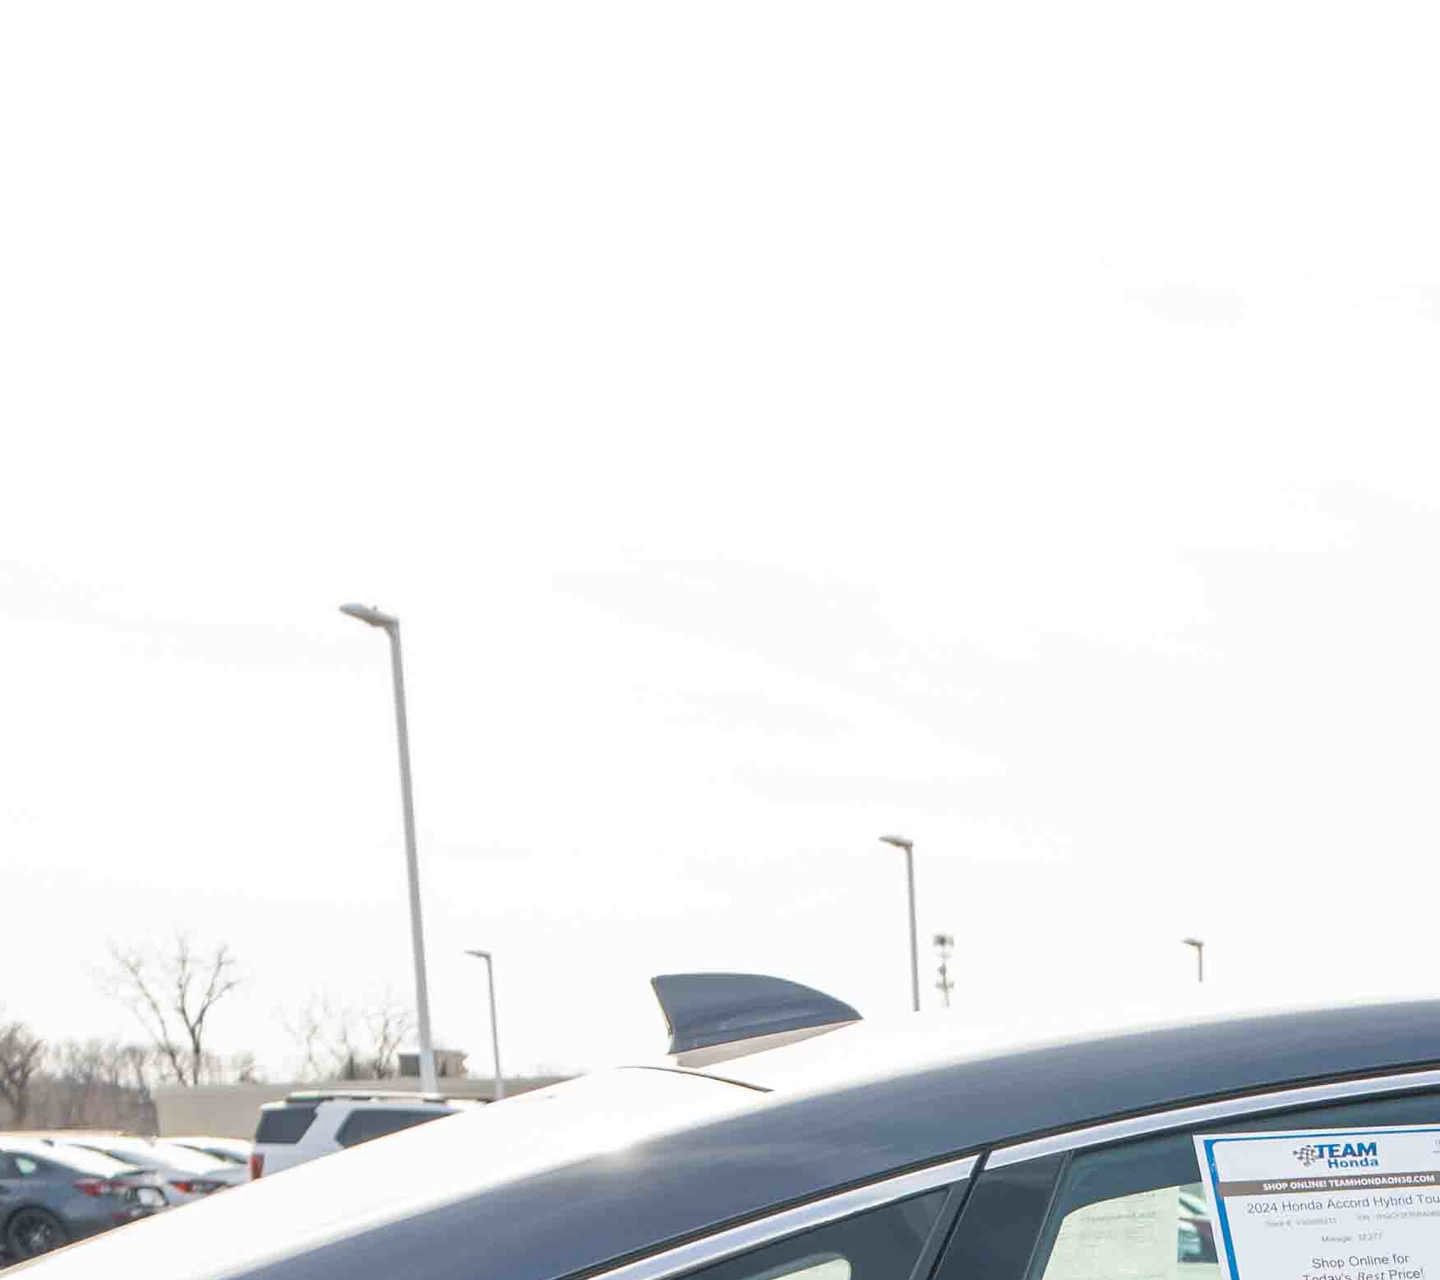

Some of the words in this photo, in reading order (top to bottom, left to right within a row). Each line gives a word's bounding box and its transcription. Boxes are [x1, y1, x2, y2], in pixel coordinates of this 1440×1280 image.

[1314, 1142, 1378, 1159] TEAM
[1328, 1157, 1379, 1169] Honda
[1263, 1182, 1288, 1192] SHOP
[1290, 1179, 1327, 1190] ONLINE!
[1247, 1202, 1278, 1214] 2024
[1282, 1200, 1323, 1212] Honda
[1327, 1197, 1371, 1209] Accord
[1374, 1195, 1413, 1210] Hybrid
[1312, 1257, 1345, 1271] Shop
[1349, 1255, 1389, 1267] Online
[1392, 1253, 1410, 1264] for
[1389, 1268, 1425, 1280] Price!
